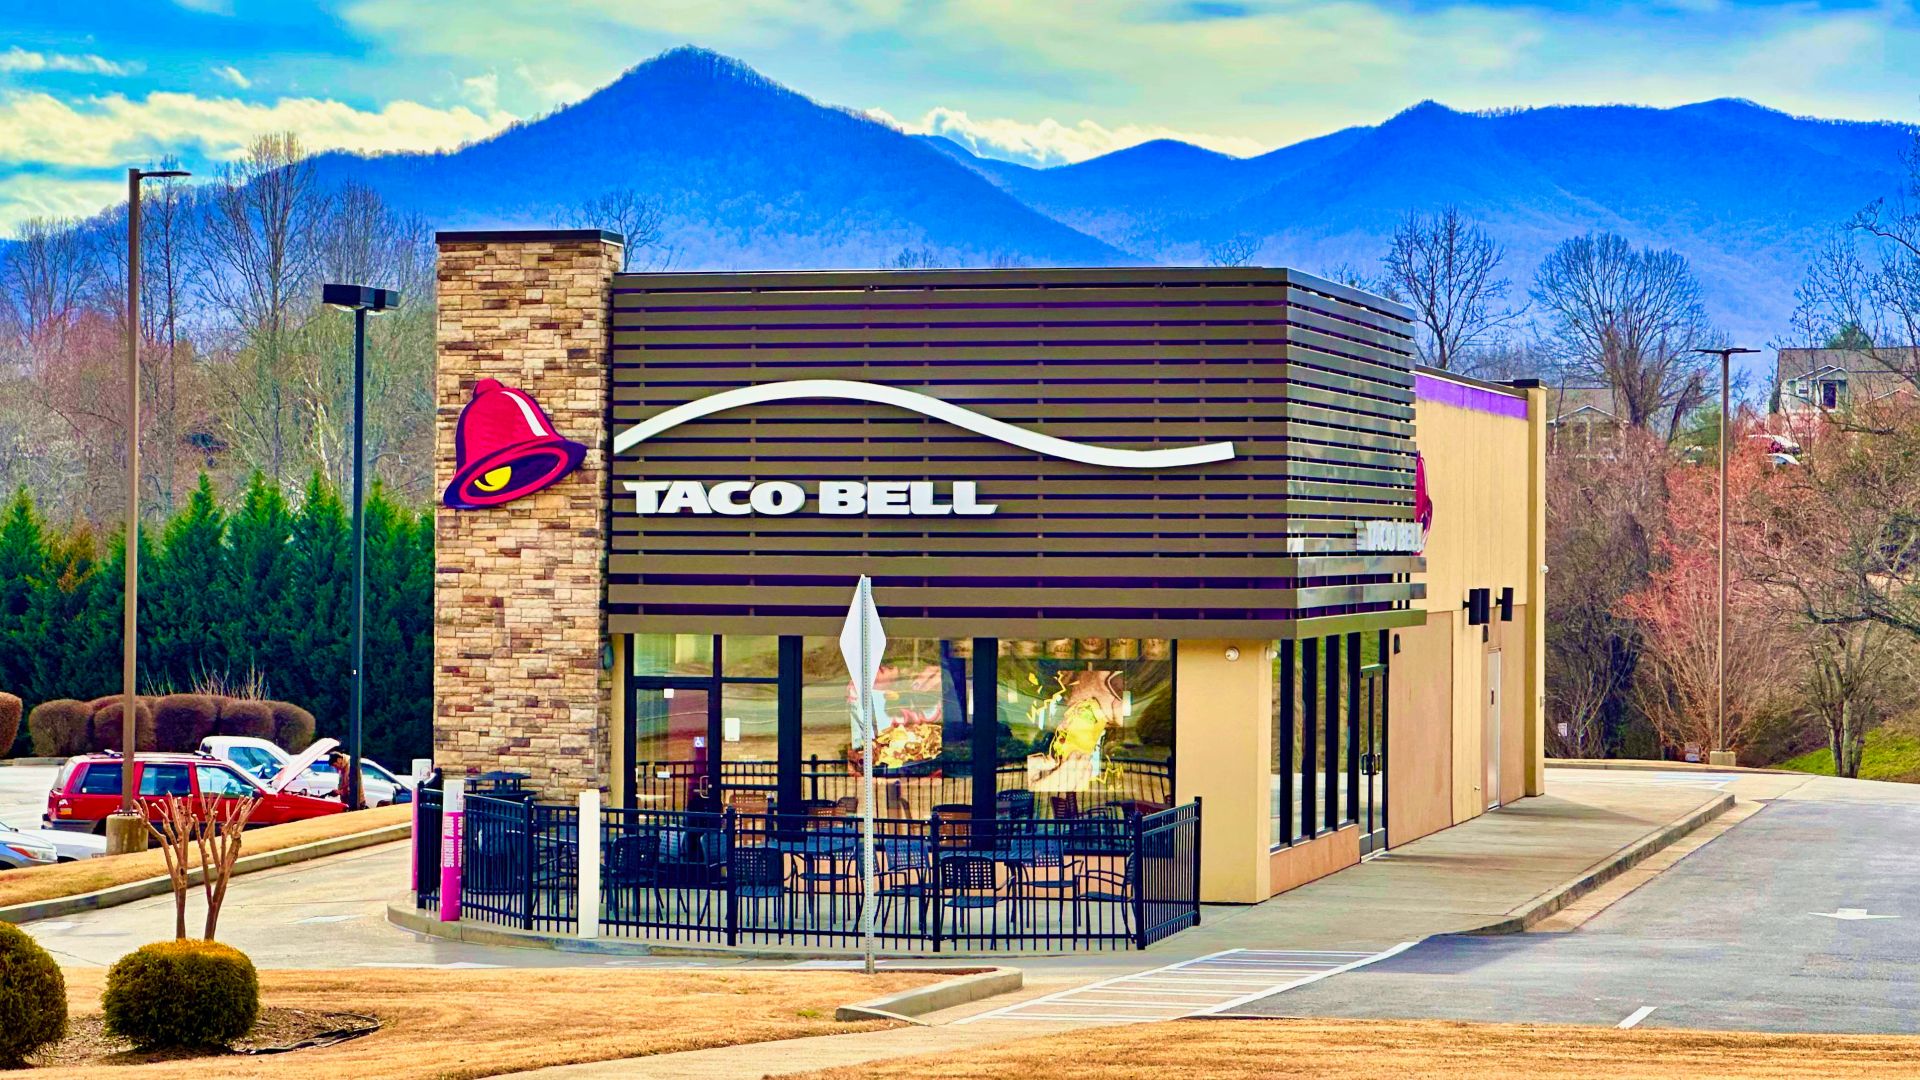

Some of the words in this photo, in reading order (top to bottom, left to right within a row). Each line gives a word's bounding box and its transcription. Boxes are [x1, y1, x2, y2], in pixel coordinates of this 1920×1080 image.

[622, 480, 806, 515] TACO
[818, 480, 998, 515] BELL
[443, 816, 455, 837] NOW
[443, 838, 455, 868] HIRING
